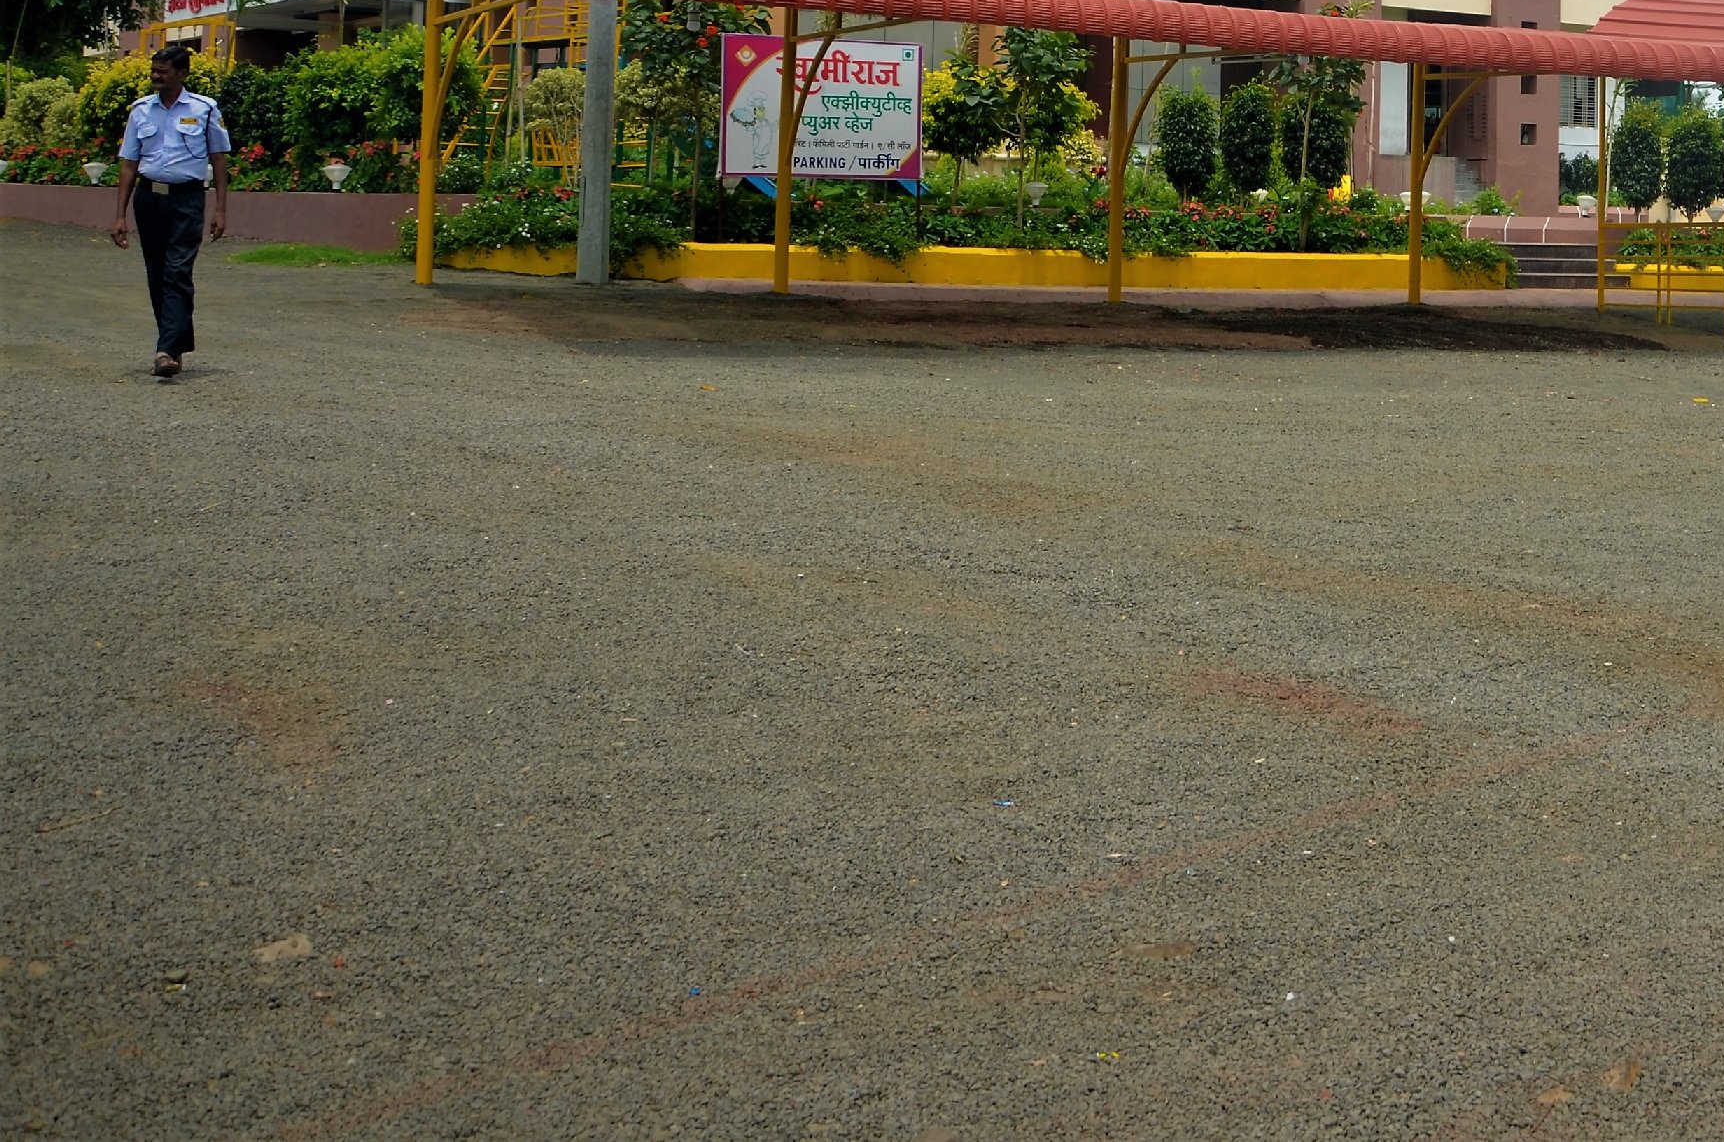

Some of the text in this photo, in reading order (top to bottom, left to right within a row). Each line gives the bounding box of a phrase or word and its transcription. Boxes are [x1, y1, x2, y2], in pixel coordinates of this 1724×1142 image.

[800, 111, 874, 135] प्युअर व्हेज
[793, 156, 846, 169] PARKING
